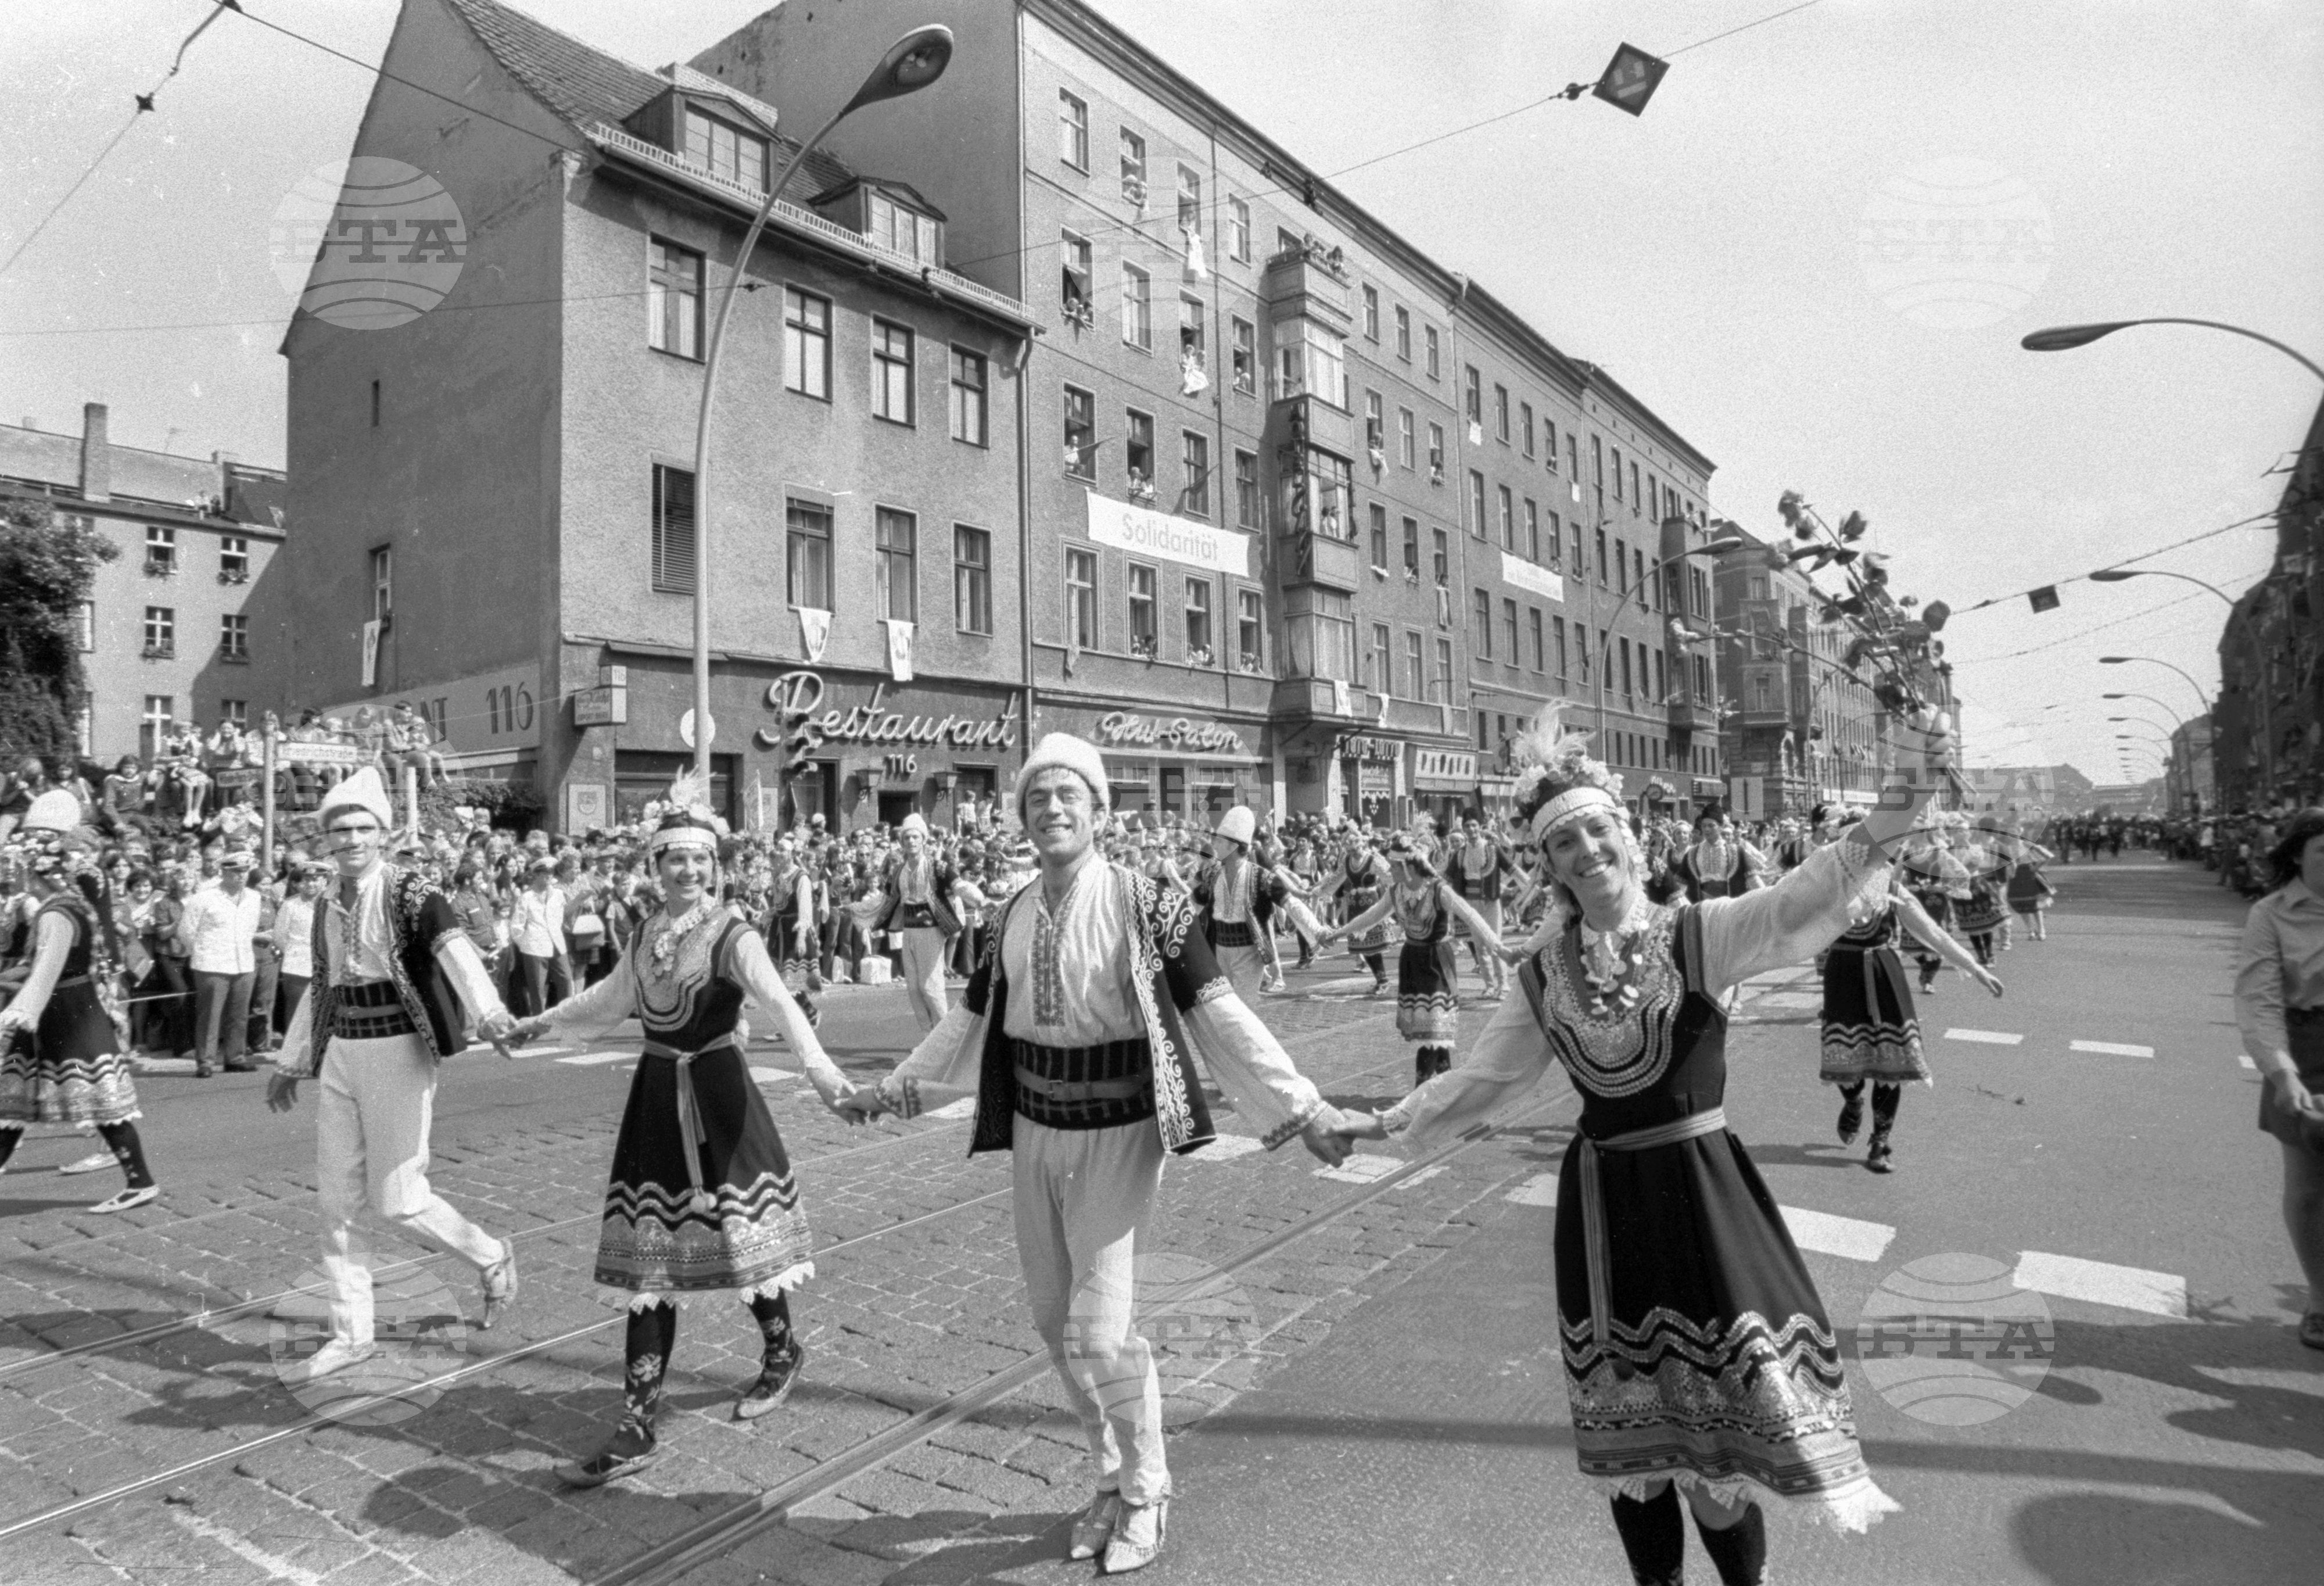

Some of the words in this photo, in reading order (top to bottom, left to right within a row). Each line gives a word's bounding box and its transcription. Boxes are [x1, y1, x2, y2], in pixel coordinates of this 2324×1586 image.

[1122, 512, 1218, 562] Solidarität
[485, 681, 534, 735] 116
[759, 671, 1018, 747] Restaurant
[888, 754, 918, 774] 116
